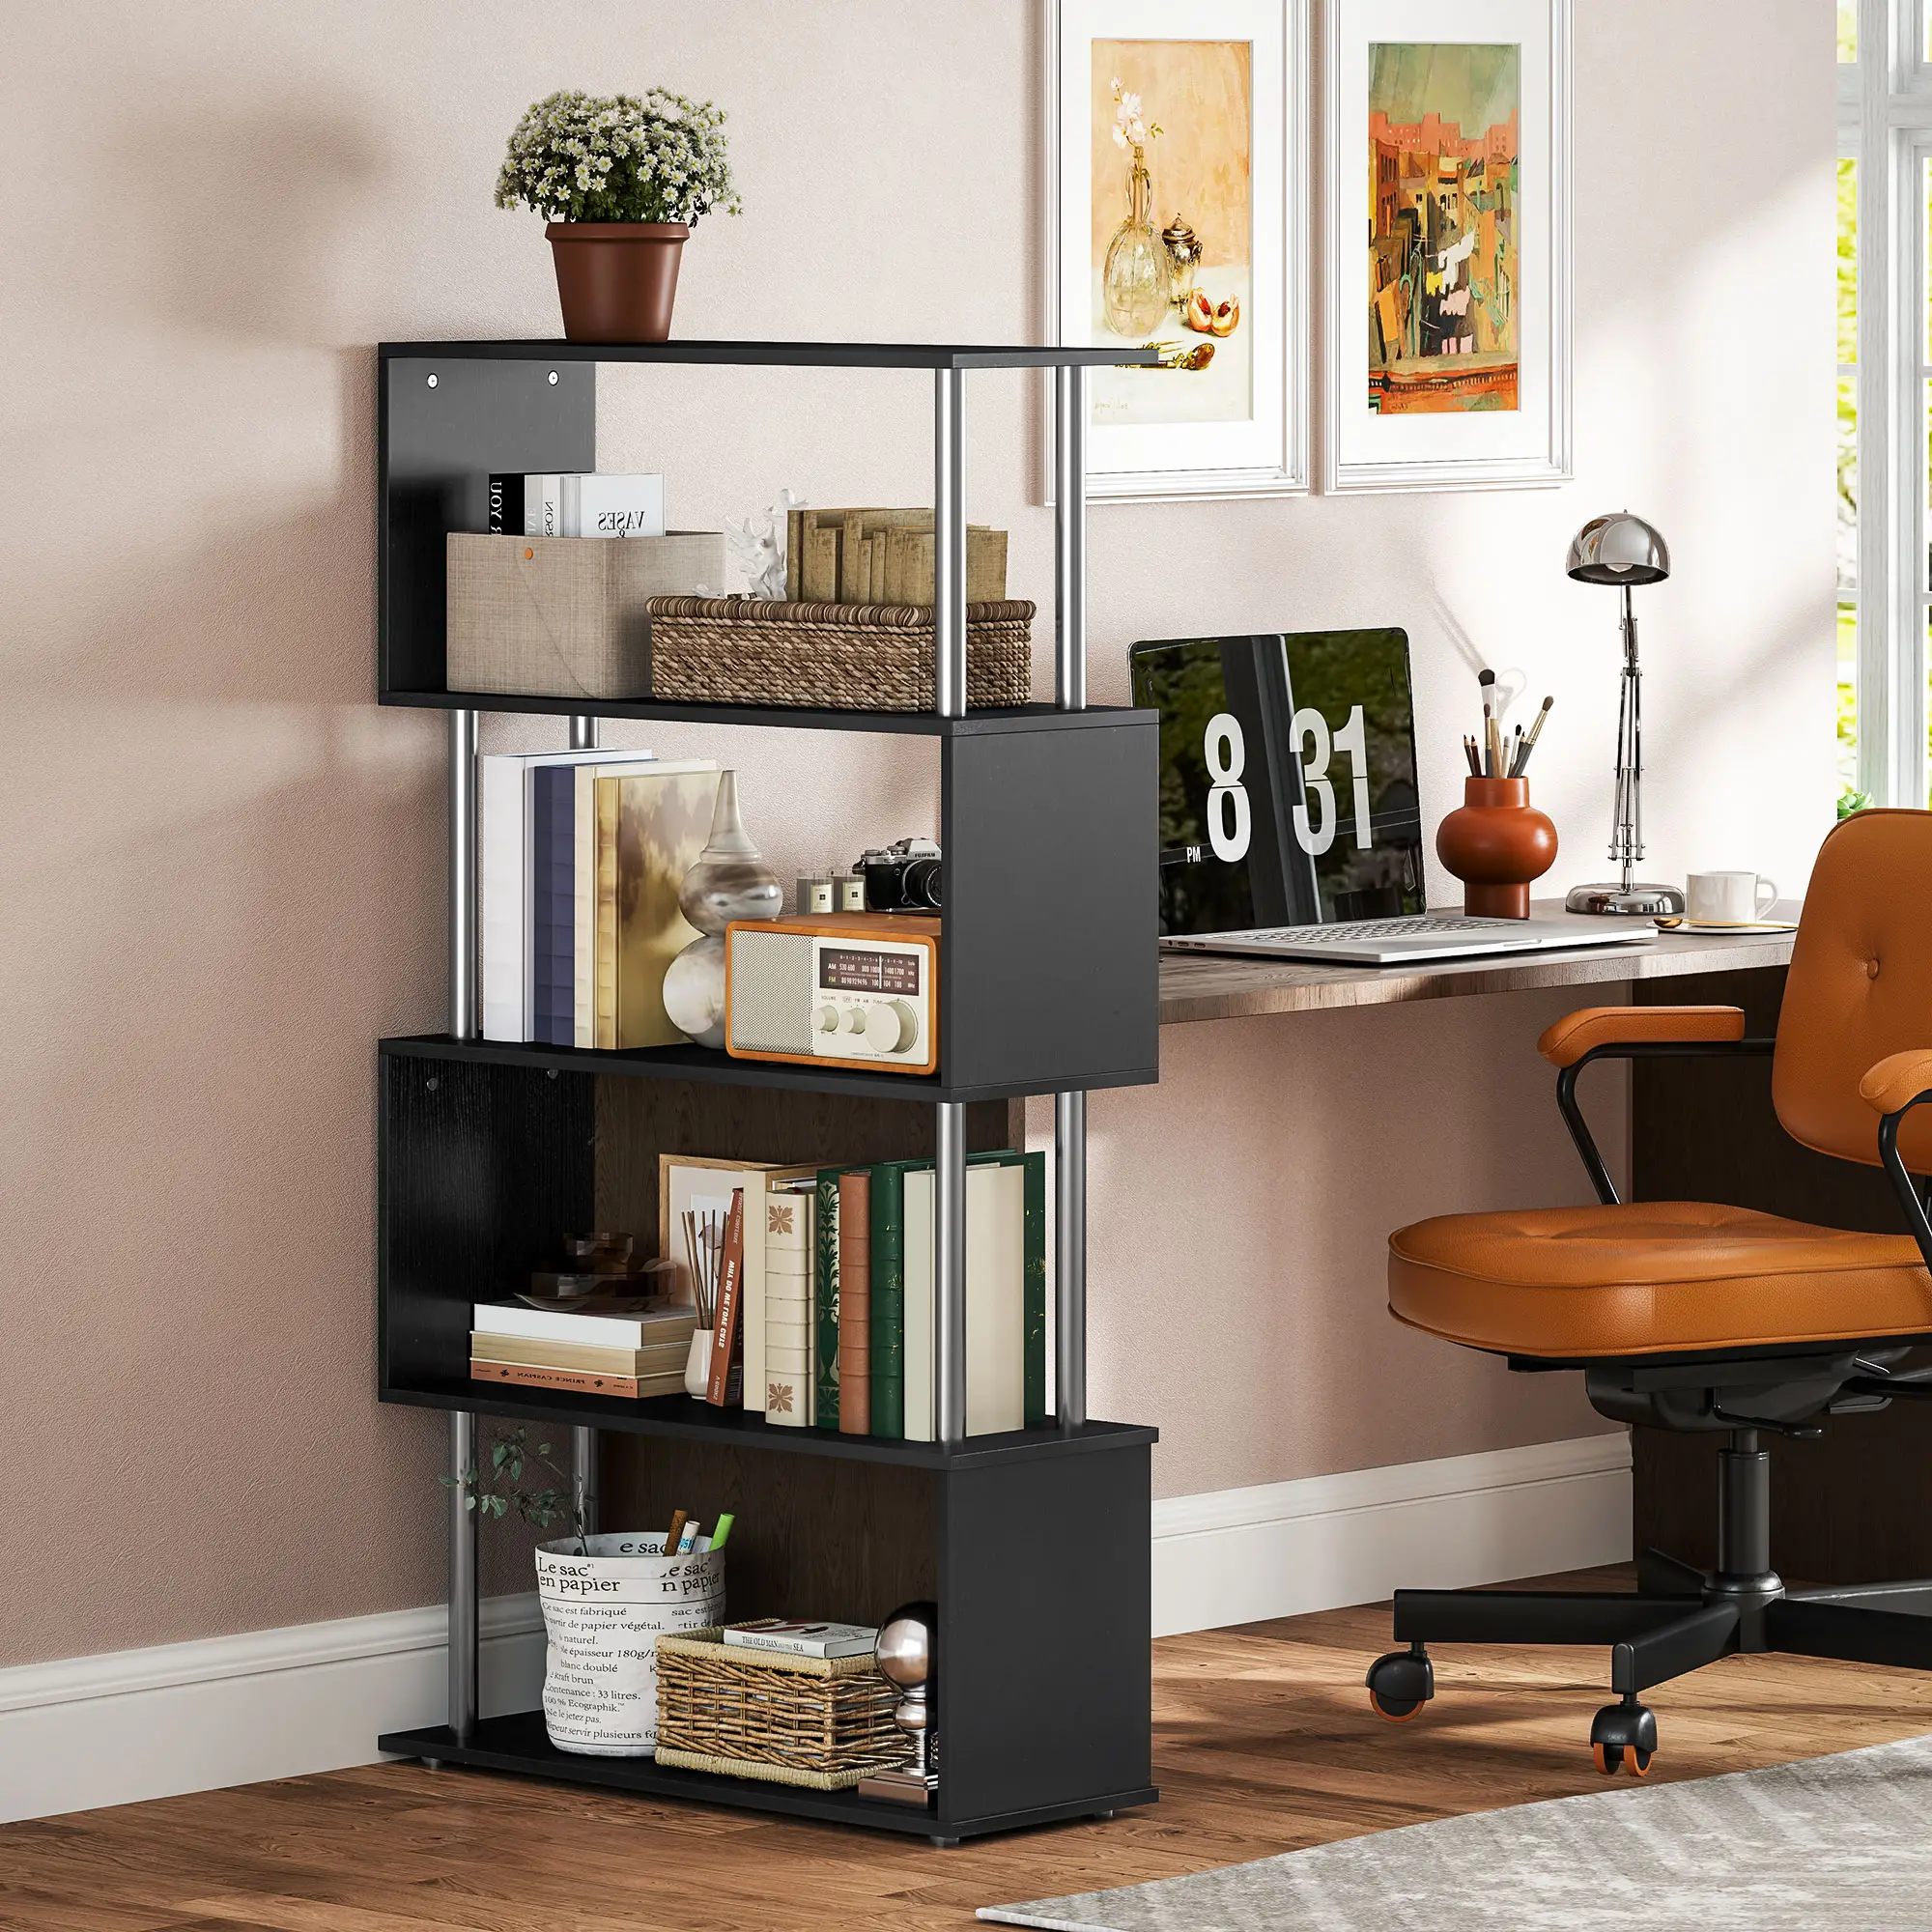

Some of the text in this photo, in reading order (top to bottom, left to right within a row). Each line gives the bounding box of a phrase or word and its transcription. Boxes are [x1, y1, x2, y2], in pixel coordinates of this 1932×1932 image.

[1204, 705, 1373, 863] 8 31
[1186, 846, 1201, 863] PM
[538, 1556, 556, 1574] Le
[540, 1576, 620, 1596] en papier
[681, 1572, 720, 1595] papier
[580, 1607, 627, 1617] fabriqué
[568, 1620, 579, 1629] de
[582, 1621, 617, 1633] papier
[620, 1621, 665, 1633] végétal.
[564, 1635, 598, 1645] naturel.
[753, 1637, 765, 1647] OLD
[793, 1643, 804, 1652] SEA
[570, 1647, 613, 1659] épaisseur
[560, 1659, 618, 1673] blanc doublé
[572, 1674, 594, 1685] brun
[598, 1690, 609, 1699] 33
[611, 1690, 641, 1700] litres.
[546, 1708, 557, 1717] Ne
[584, 1716, 602, 1725] pas.
[568, 1728, 591, 1737] servir
[593, 1729, 642, 1740] plusieurs
